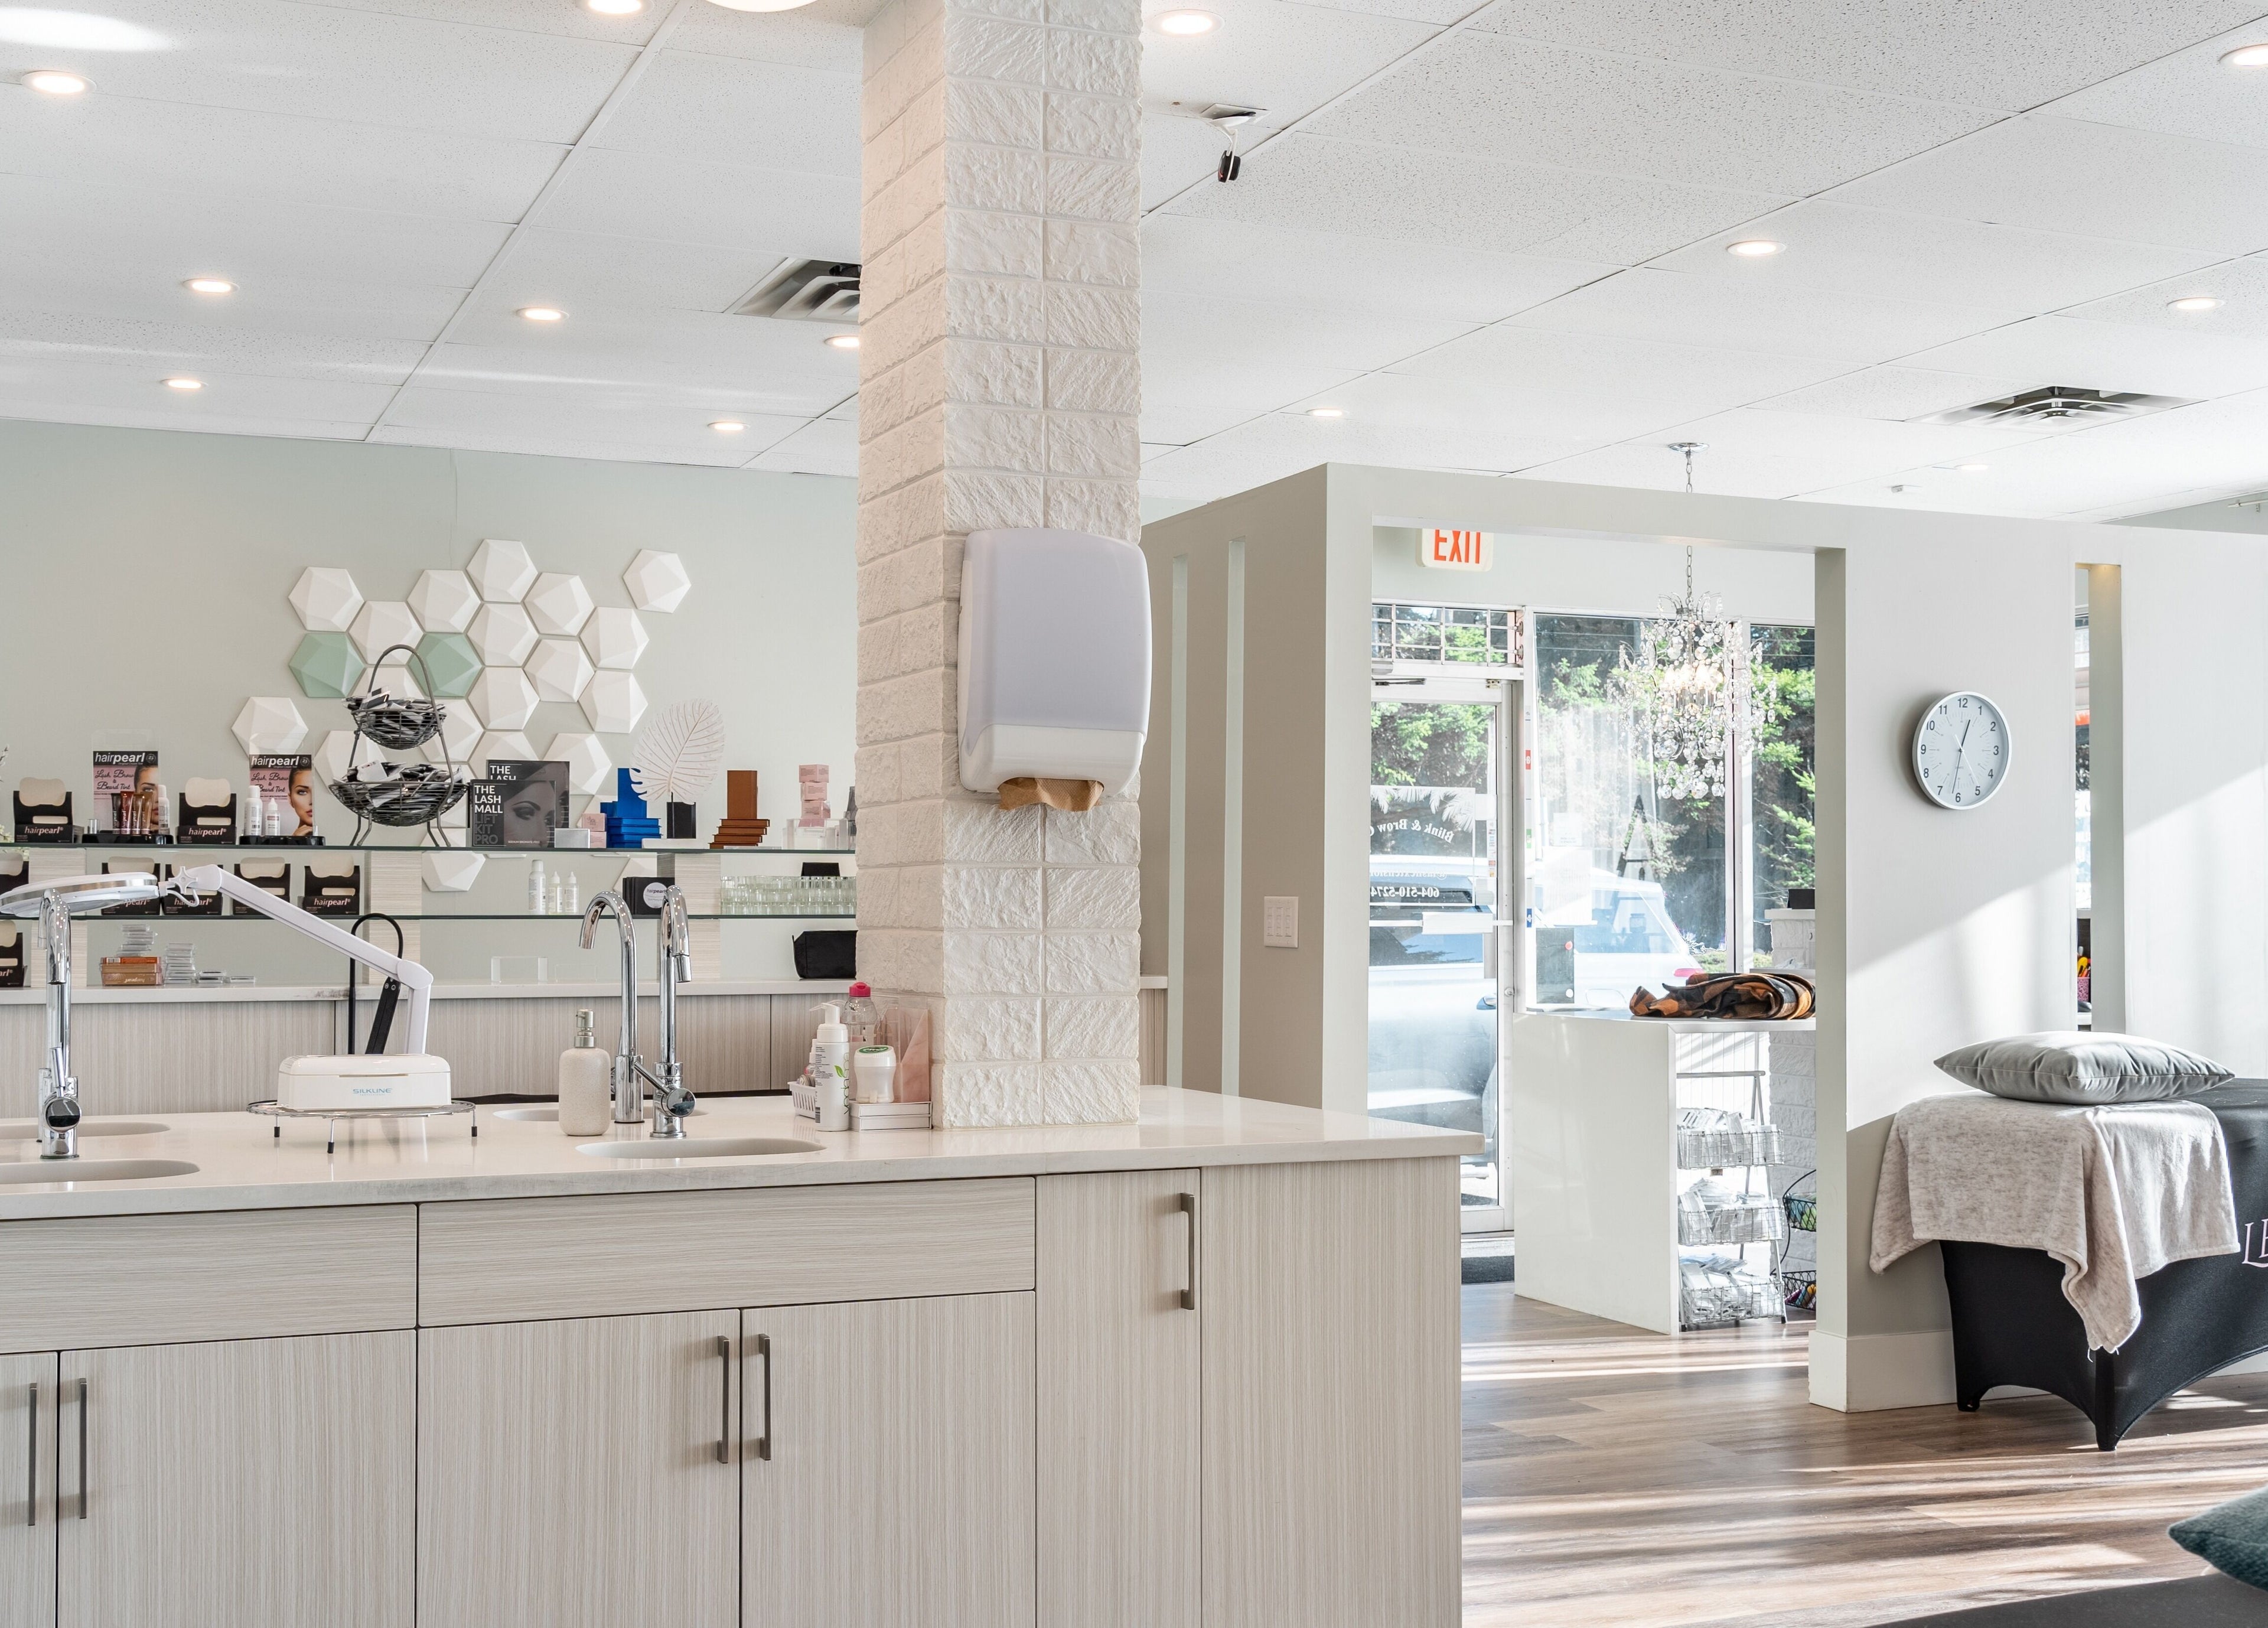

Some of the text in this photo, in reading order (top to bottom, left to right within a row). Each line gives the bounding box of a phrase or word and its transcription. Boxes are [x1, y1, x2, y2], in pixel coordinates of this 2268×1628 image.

[1433, 529, 1481, 564] EXIT
[1957, 698, 1968, 708] 12
[1938, 705, 1947, 715] 11
[1978, 705, 1982, 715] 1
[1926, 720, 1935, 731] 10
[1990, 721, 1996, 731] 2
[1920, 744, 1927, 754] 9
[1993, 745, 1999, 756] 3
[95, 753, 145, 764] hairpearl
[251, 756, 299, 768] hairpearl
[490, 766, 510, 774] THE
[1923, 768, 1929, 778] 8
[1987, 769, 1993, 779] 4
[96, 781, 119, 790] Beard
[474, 785, 495, 794] THE
[1937, 786, 1943, 795] 7
[1974, 786, 1980, 796] 5
[474, 795, 501, 804] LASH
[1955, 793, 1961, 803] 6
[474, 805, 503, 813] MALL
[475, 814, 498, 823] LIFT
[475, 824, 493, 834] KIT
[475, 834, 498, 844] PRO
